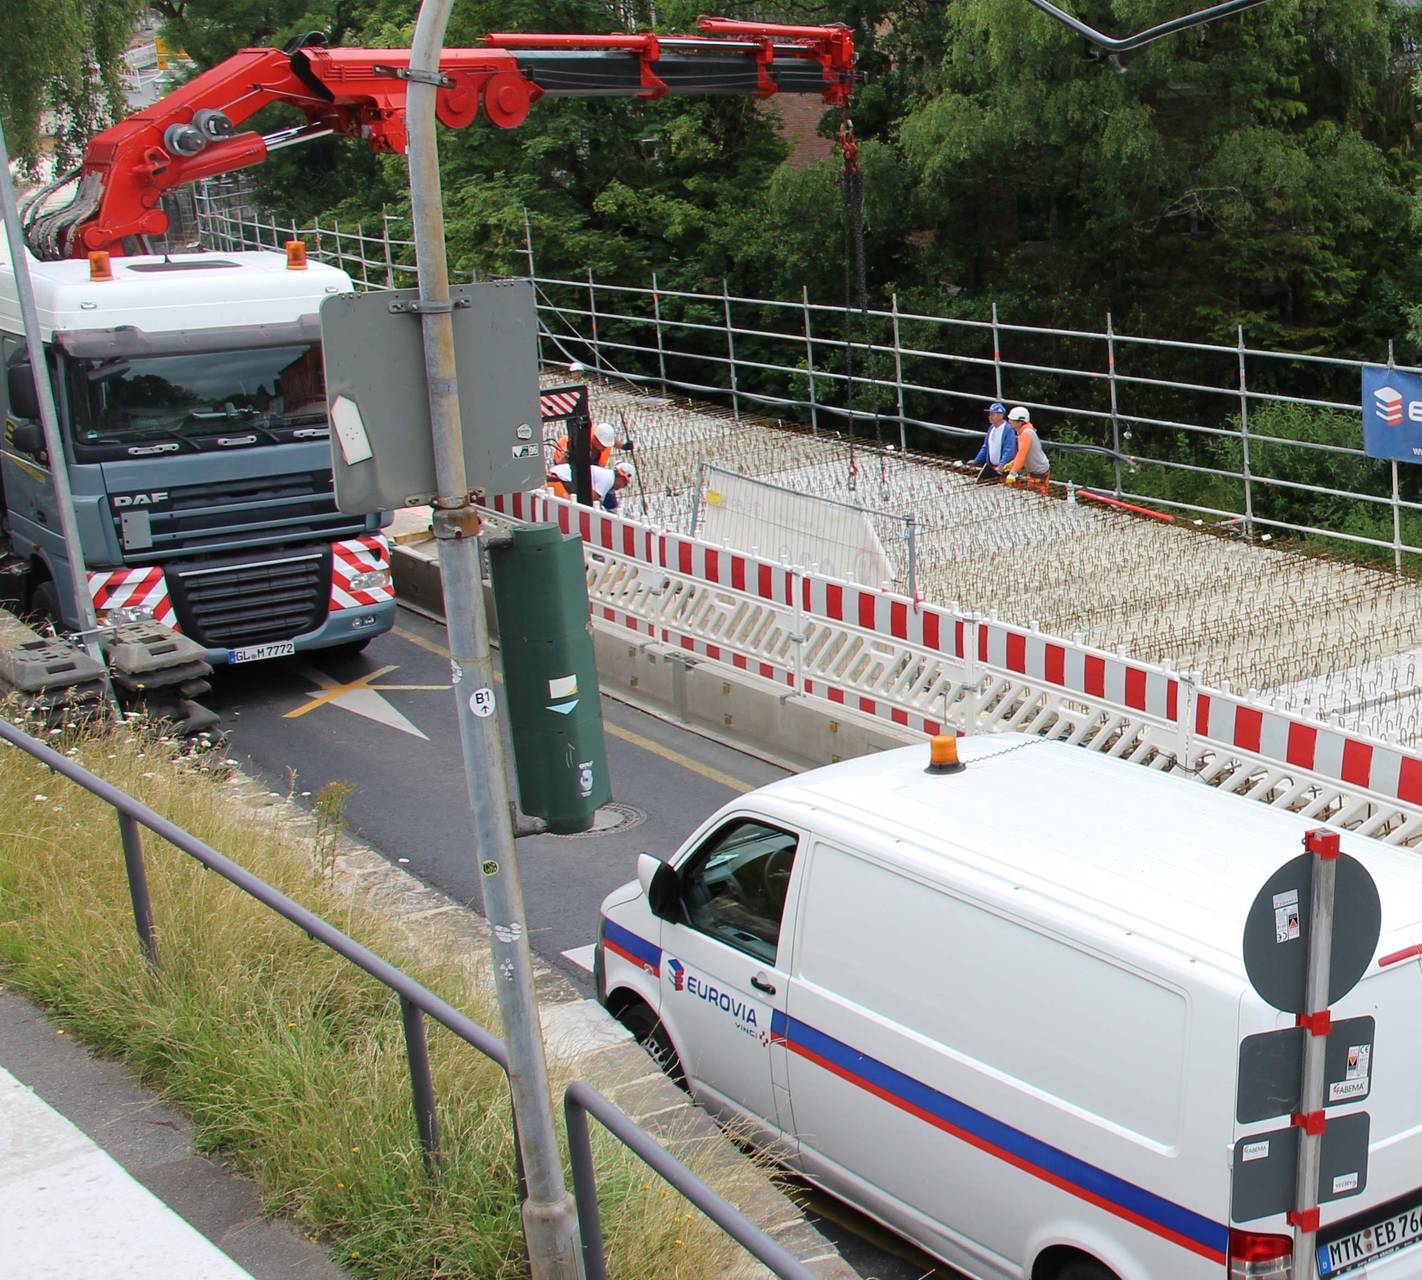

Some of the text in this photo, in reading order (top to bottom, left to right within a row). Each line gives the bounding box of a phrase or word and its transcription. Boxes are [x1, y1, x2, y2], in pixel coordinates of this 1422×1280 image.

[113, 491, 169, 507] DAF
[236, 643, 293, 661] GL M 7772
[475, 691, 490, 704] B1
[687, 976, 757, 1027] EUROVIA
[735, 1022, 758, 1039] VINCI
[1329, 1234, 1364, 1266] MTK
[1374, 1221, 1396, 1248] EB
